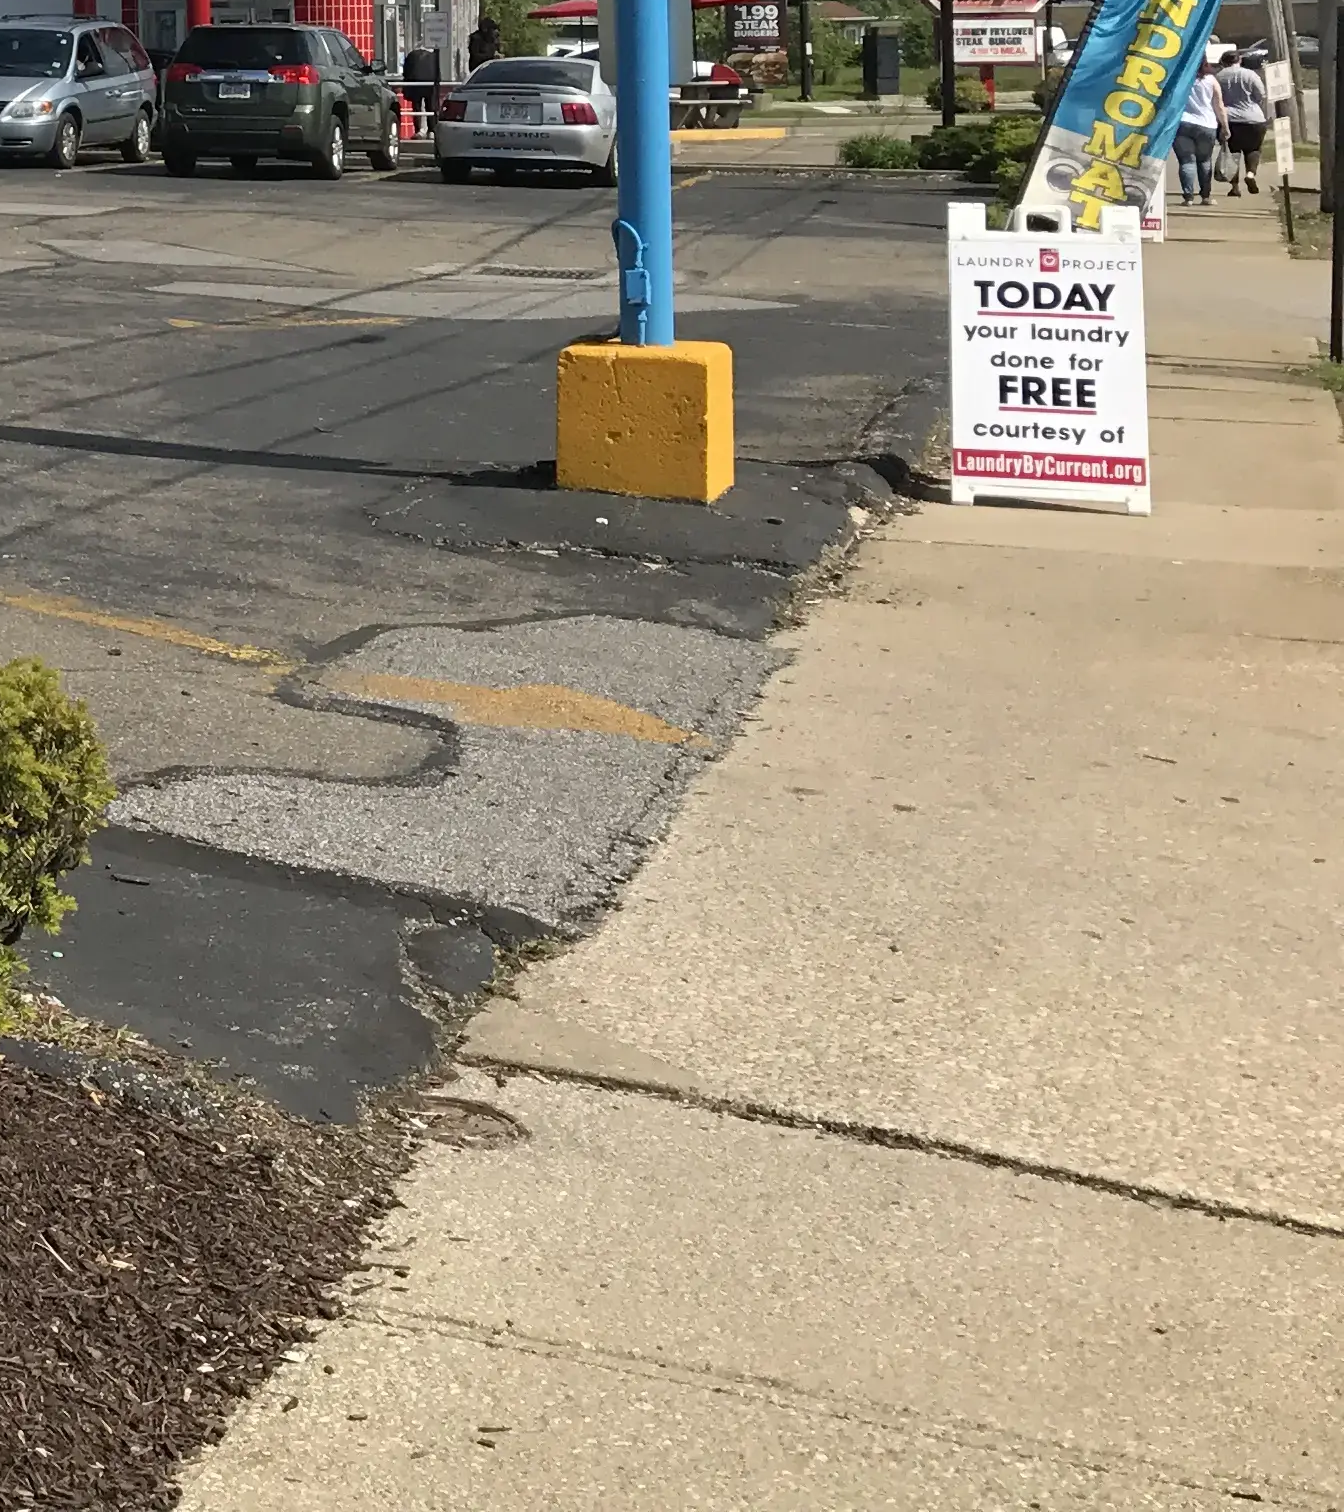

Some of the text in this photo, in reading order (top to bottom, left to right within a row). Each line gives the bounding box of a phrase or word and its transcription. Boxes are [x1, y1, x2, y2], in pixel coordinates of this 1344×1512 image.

[734, 5, 779, 20] $1.99
[734, 20, 779, 30] STEAK
[734, 29, 779, 37] BURGERS
[956, 37, 983, 45] STEAK
[473, 131, 550, 139] MUSTANG
[957, 257, 1137, 271] LAUNDRY PROJECT
[974, 280, 1115, 312] TODAY
[964, 324, 1130, 347] your laundry
[990, 350, 1103, 372] done for
[998, 375, 1097, 408] FREE
[973, 422, 1125, 445] courtesy of
[957, 452, 1142, 483] LaundryByCurrent.org
